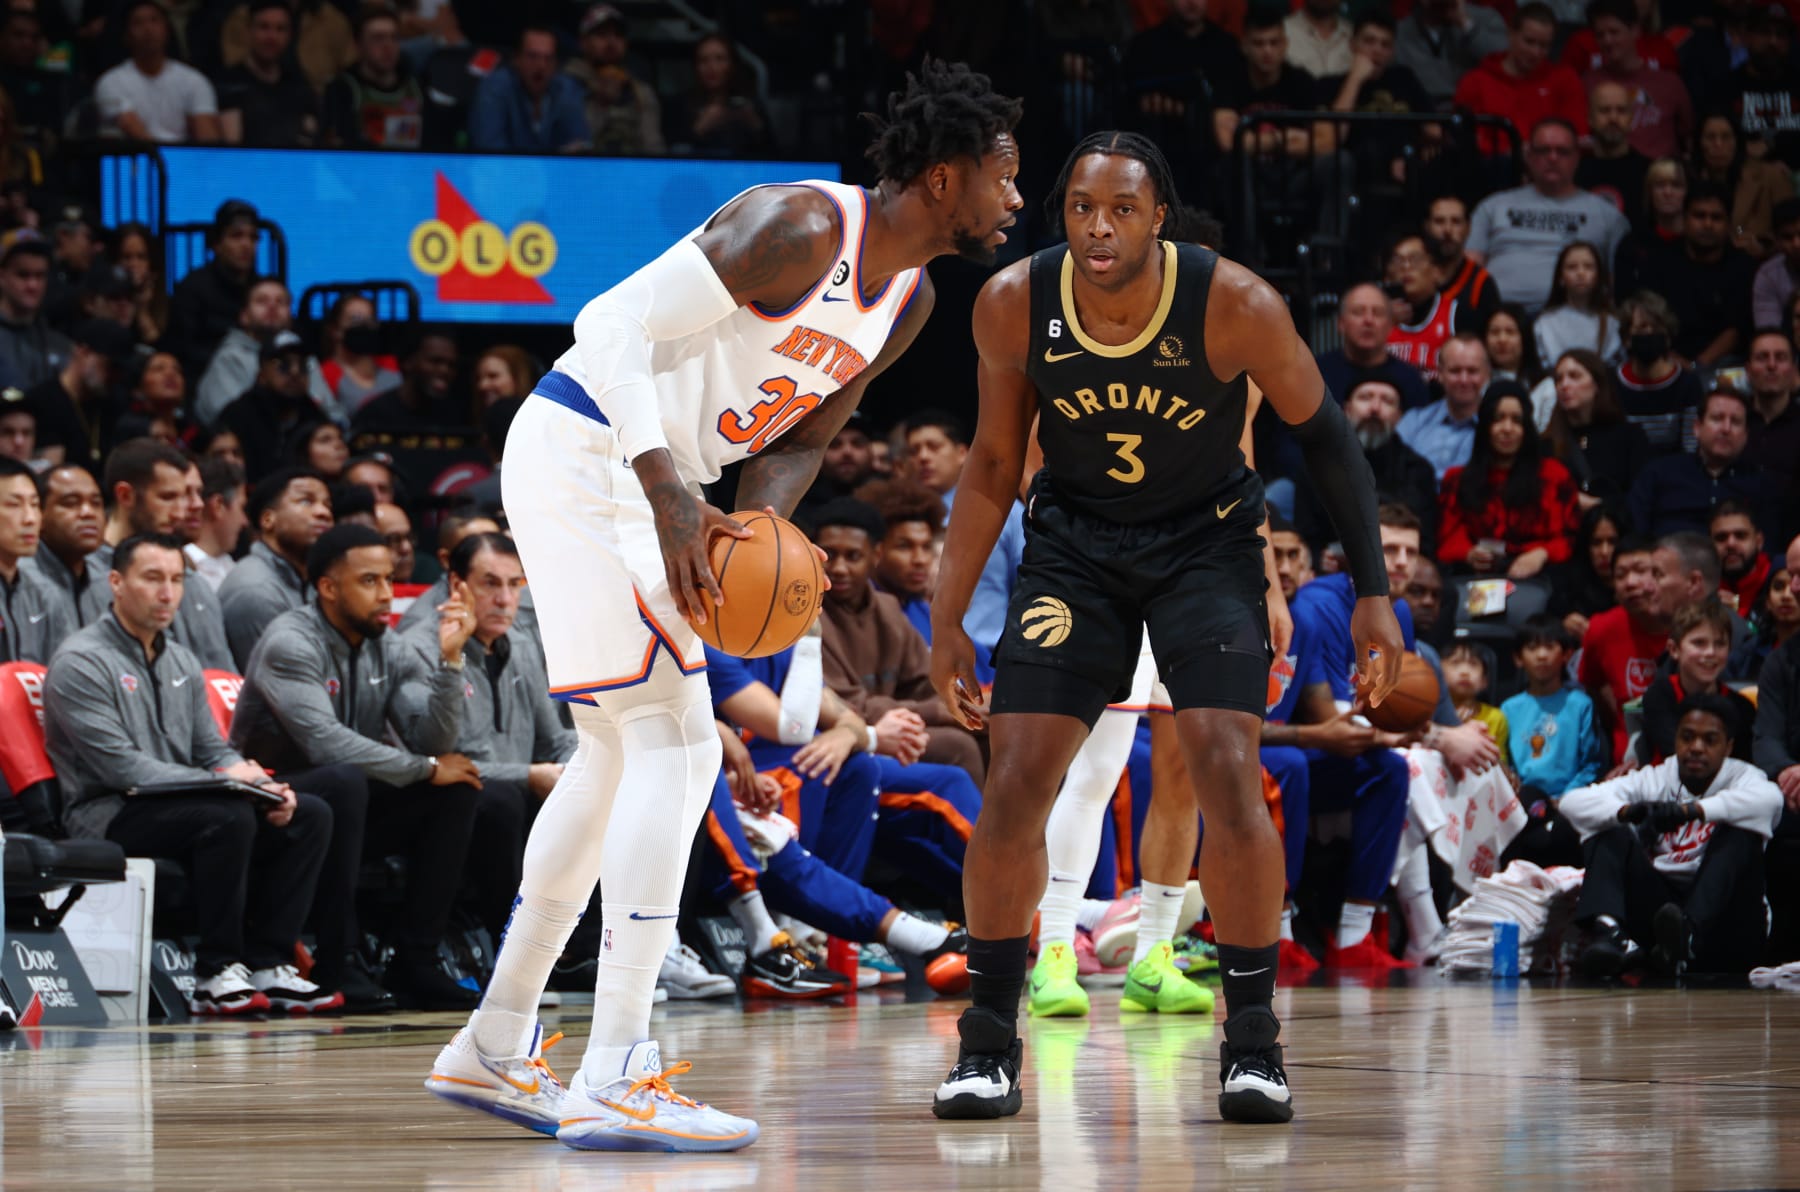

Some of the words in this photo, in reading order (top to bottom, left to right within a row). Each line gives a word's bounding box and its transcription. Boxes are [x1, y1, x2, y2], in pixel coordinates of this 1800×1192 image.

[421, 231, 544, 266] OLG
[833, 263, 847, 284] 6
[1048, 319, 1062, 338] 6
[770, 325, 838, 368] NEW
[1152, 359, 1172, 367] Sun
[1173, 358, 1191, 367] Life
[717, 375, 823, 454] 30
[1105, 432, 1146, 484] 3
[11, 940, 59, 971] Dove
[27, 976, 59, 992] MEN
